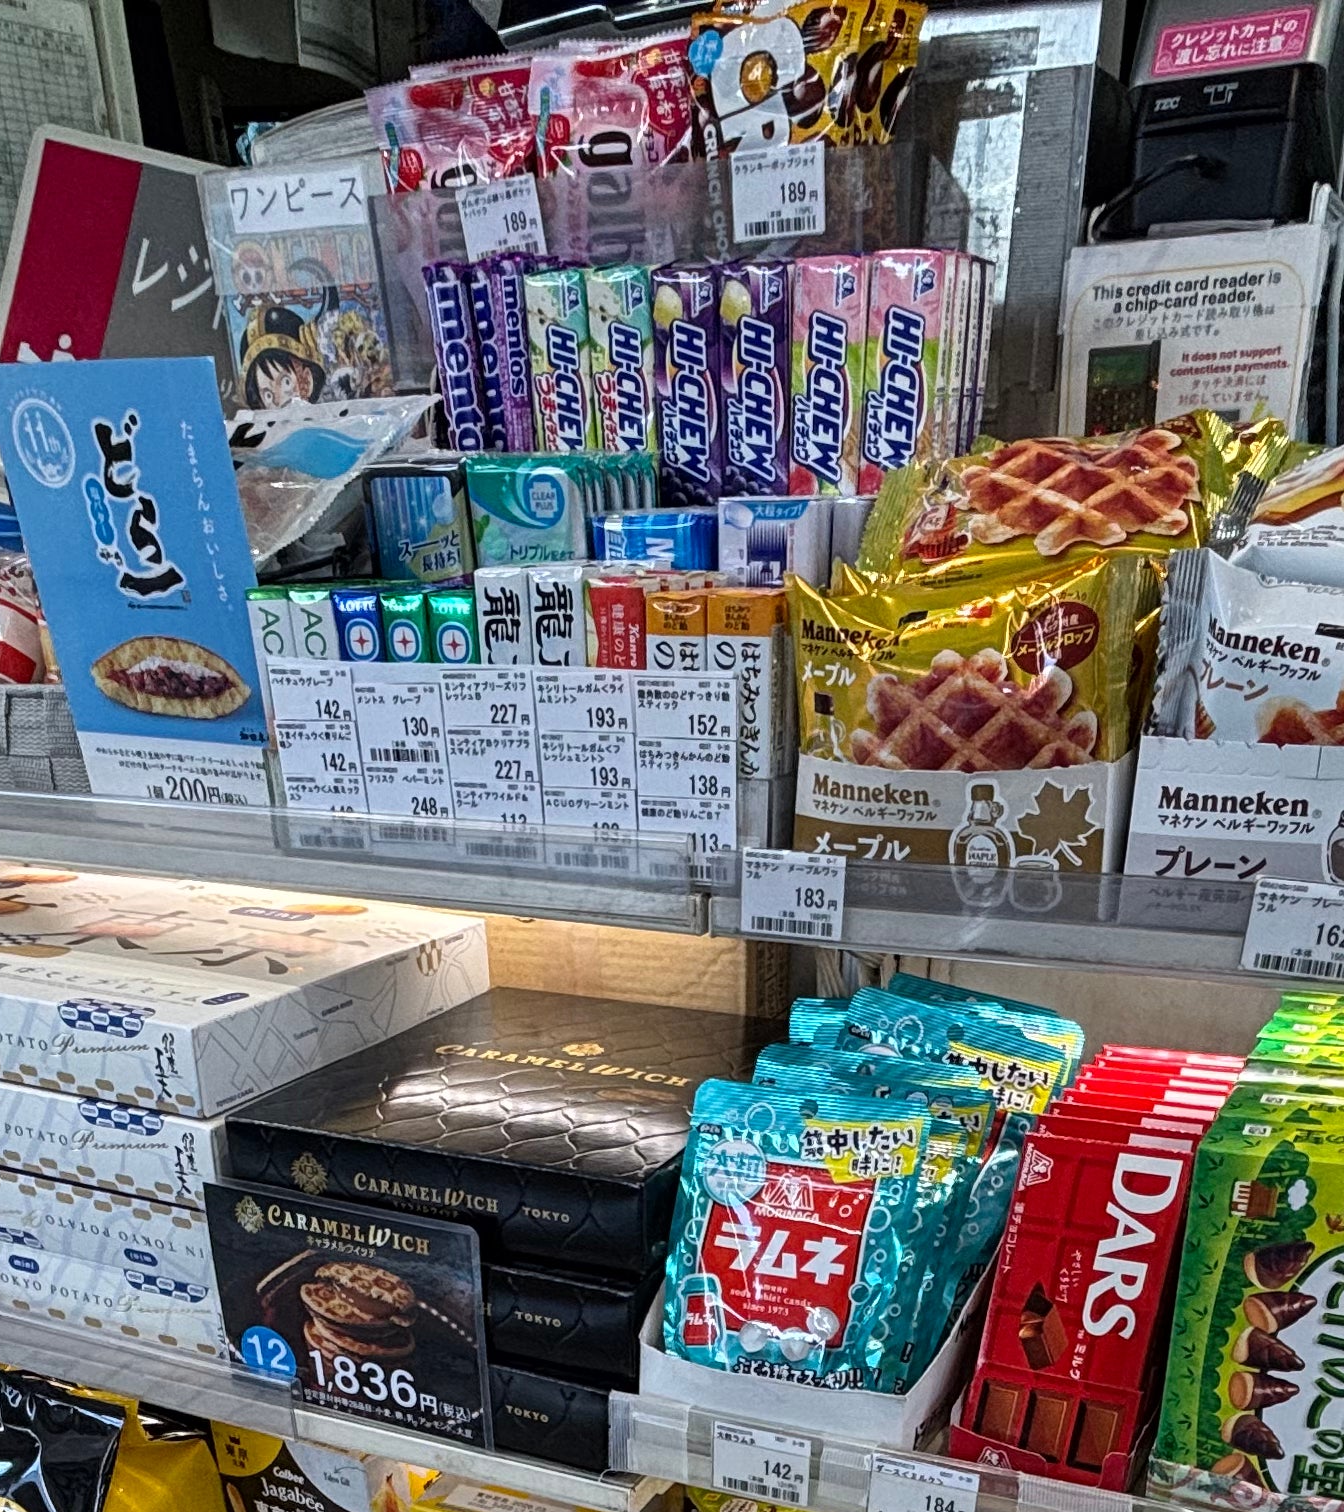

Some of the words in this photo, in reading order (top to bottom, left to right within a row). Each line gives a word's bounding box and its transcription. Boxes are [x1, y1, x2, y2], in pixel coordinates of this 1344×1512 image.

[1170, 18, 1298, 48] クレジットカードの
[1175, 34, 1285, 66] 渡し忘れに注意
[1154, 96, 1181, 112] TEC
[228, 176, 363, 224] ワンピース
[779, 181, 819, 204] 189円
[502, 211, 539, 234] 189円
[1093, 284, 1123, 301] This
[1126, 280, 1171, 299] credit
[1174, 276, 1209, 294] card
[1212, 273, 1264, 290] reader
[1268, 270, 1282, 285] is
[1113, 302, 1122, 314] a
[1125, 294, 1203, 314] chip-card
[1207, 289, 1257, 306] reader.
[502, 273, 527, 399] mentos
[1182, 352, 1190, 363] It
[1191, 350, 1217, 363] does
[1219, 349, 1237, 361] not
[1239, 345, 1282, 362] support
[670, 315, 715, 484] HI-CHEW
[736, 313, 778, 484] HI-CHEW
[807, 308, 850, 486] HI-CHEW
[531, 490, 558, 501] CLEAR
[753, 504, 805, 521] 大粒タイプ!
[340, 599, 377, 613] LOTTE
[432, 601, 471, 614] LOTTE
[801, 616, 902, 651] Manneken
[1206, 613, 1321, 663] Manneken
[271, 677, 334, 687] ハイチュウグレープ
[801, 660, 856, 687] メープル
[315, 699, 352, 720] 142円
[490, 703, 531, 725] 227円
[587, 706, 628, 729] 193円
[402, 716, 440, 738] 130円
[688, 714, 731, 738] 152円
[322, 752, 358, 773] 142円
[495, 760, 534, 781] 227円
[590, 766, 631, 788] 193円
[689, 774, 731, 798] 138円
[812, 772, 931, 807] Manneken
[411, 796, 449, 818] 248円
[812, 800, 851, 816] マネケン
[853, 804, 937, 823] ベルギーワッフル
[1158, 785, 1310, 818] Manneken
[1158, 813, 1206, 831] マネケン
[1209, 815, 1315, 835] ベルギーワッフル
[811, 832, 910, 861] メープル
[1155, 847, 1267, 879] プレーン
[794, 886, 838, 911] 183円
[4, 1122, 68, 1149] POTATO
[801, 1124, 915, 1160] 集中したい
[849, 1152, 902, 1178] 時に!
[354, 1172, 500, 1215] CARAMELWICH
[522, 1207, 571, 1225] TOKYO
[754, 1206, 820, 1223] MORINAGA
[267, 1203, 430, 1256] CARAMELWICH
[712, 1220, 852, 1286] ラムネ
[1081, 1150, 1184, 1342] DARS
[246, 1333, 292, 1372] 12
[273, 1465, 305, 1485] Calbee
